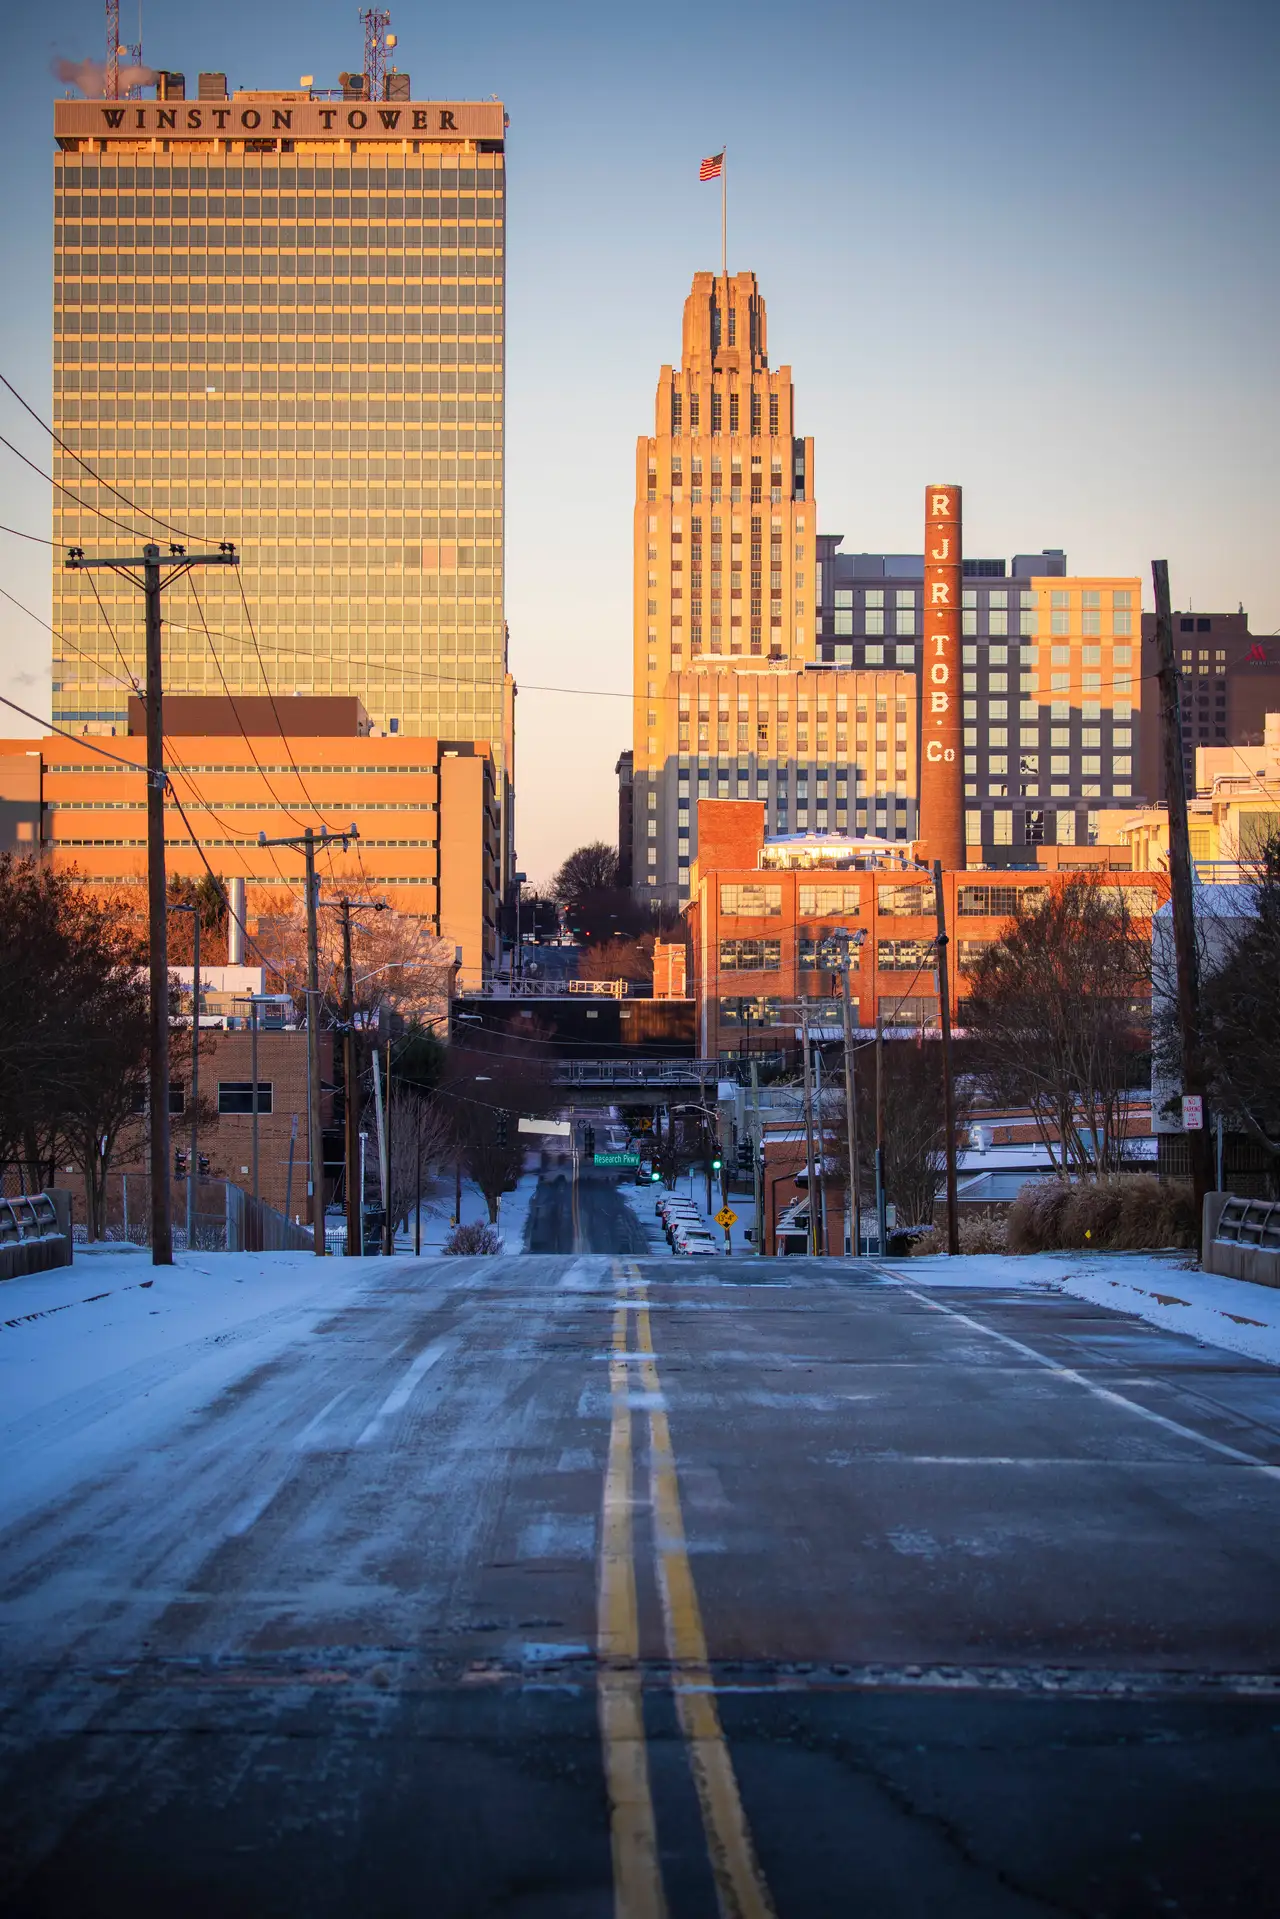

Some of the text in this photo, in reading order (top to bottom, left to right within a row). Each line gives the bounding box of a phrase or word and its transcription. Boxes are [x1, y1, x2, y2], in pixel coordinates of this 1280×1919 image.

[101, 110, 458, 129] WINSTON TOWER
[595, 1154, 640, 1165] Research Pkwy
